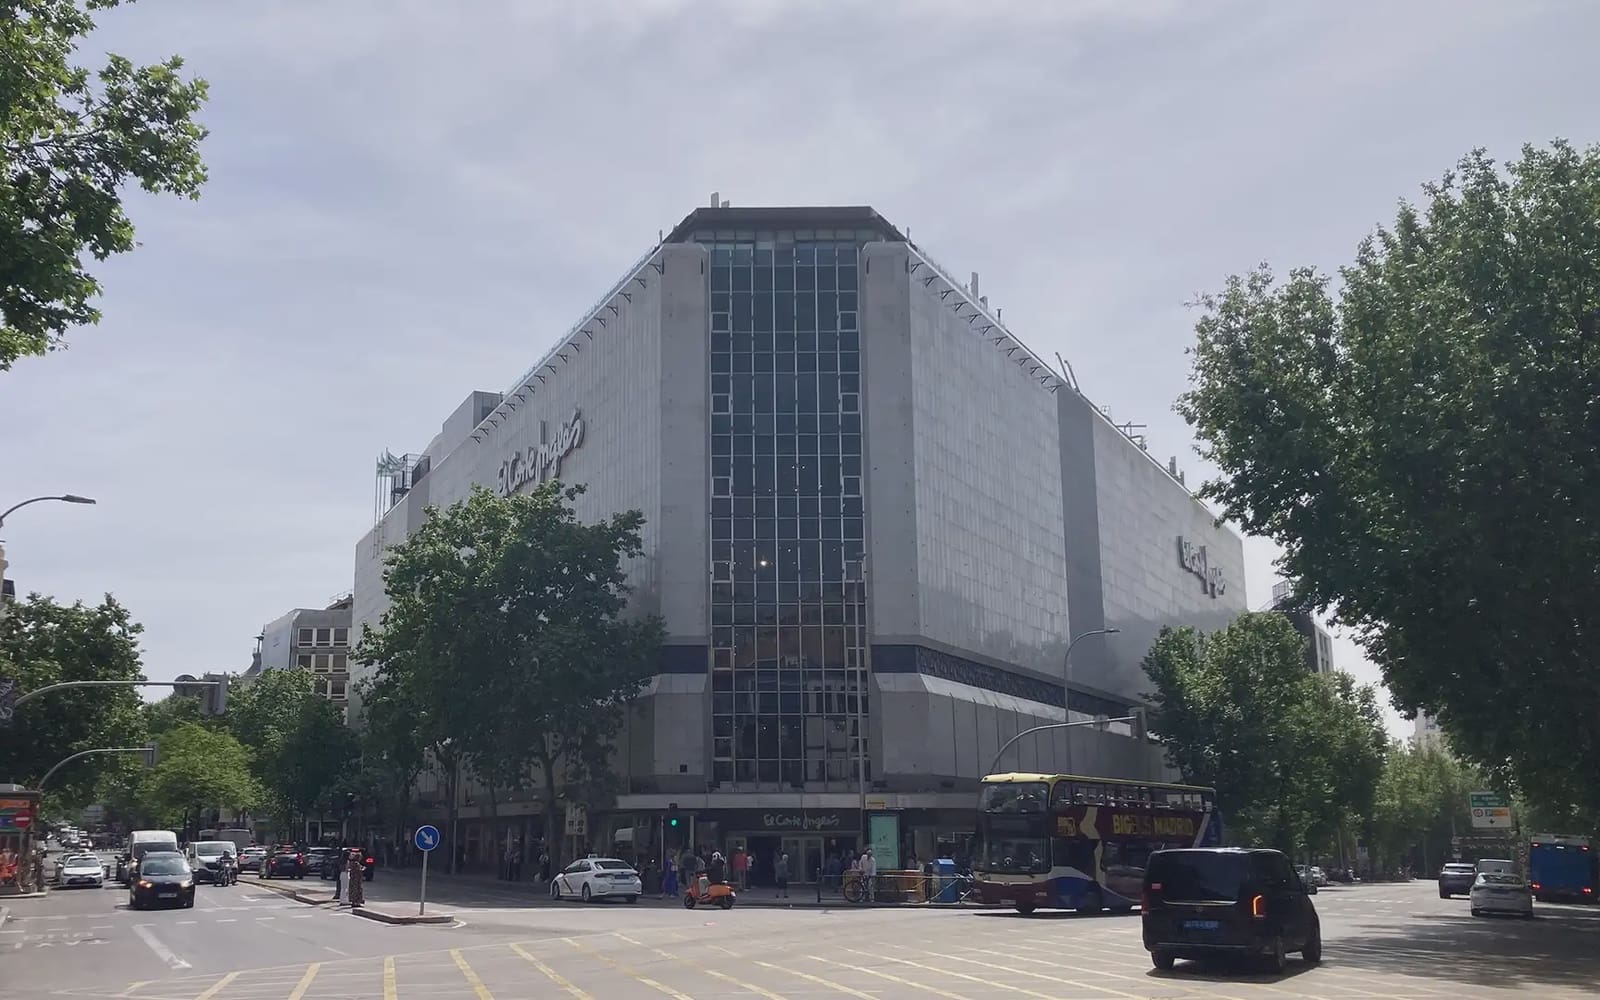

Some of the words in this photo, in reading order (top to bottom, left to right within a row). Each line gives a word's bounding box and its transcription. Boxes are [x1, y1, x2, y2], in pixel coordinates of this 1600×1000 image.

[508, 447, 538, 492] Corte
[763, 813, 775, 826] El
[775, 813, 801, 826] Corte
[802, 809, 840, 830] Inglés
[1152, 816, 1194, 836] MADRID
